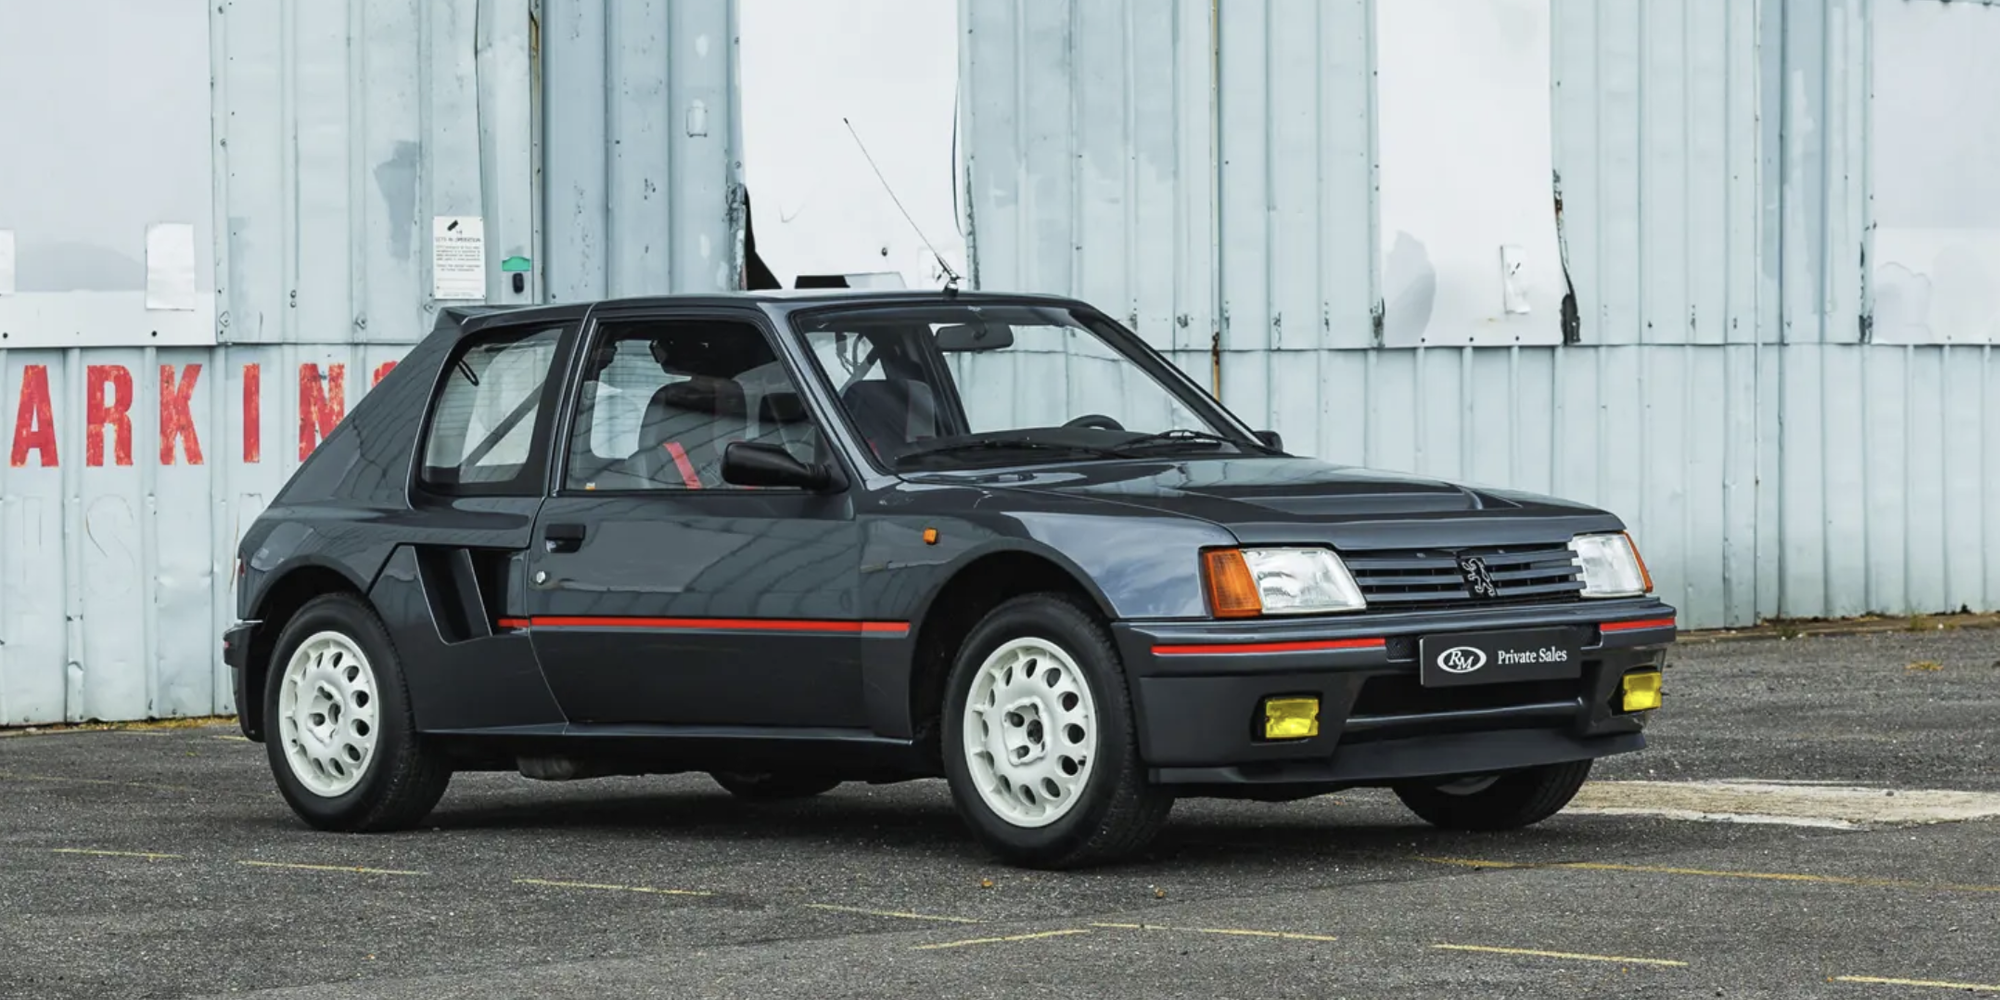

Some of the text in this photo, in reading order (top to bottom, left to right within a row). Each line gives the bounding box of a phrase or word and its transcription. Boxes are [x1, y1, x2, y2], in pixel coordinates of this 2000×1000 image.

[10, 361, 401, 467] ARKIN
[1448, 646, 1568, 670] RM Private Sales
